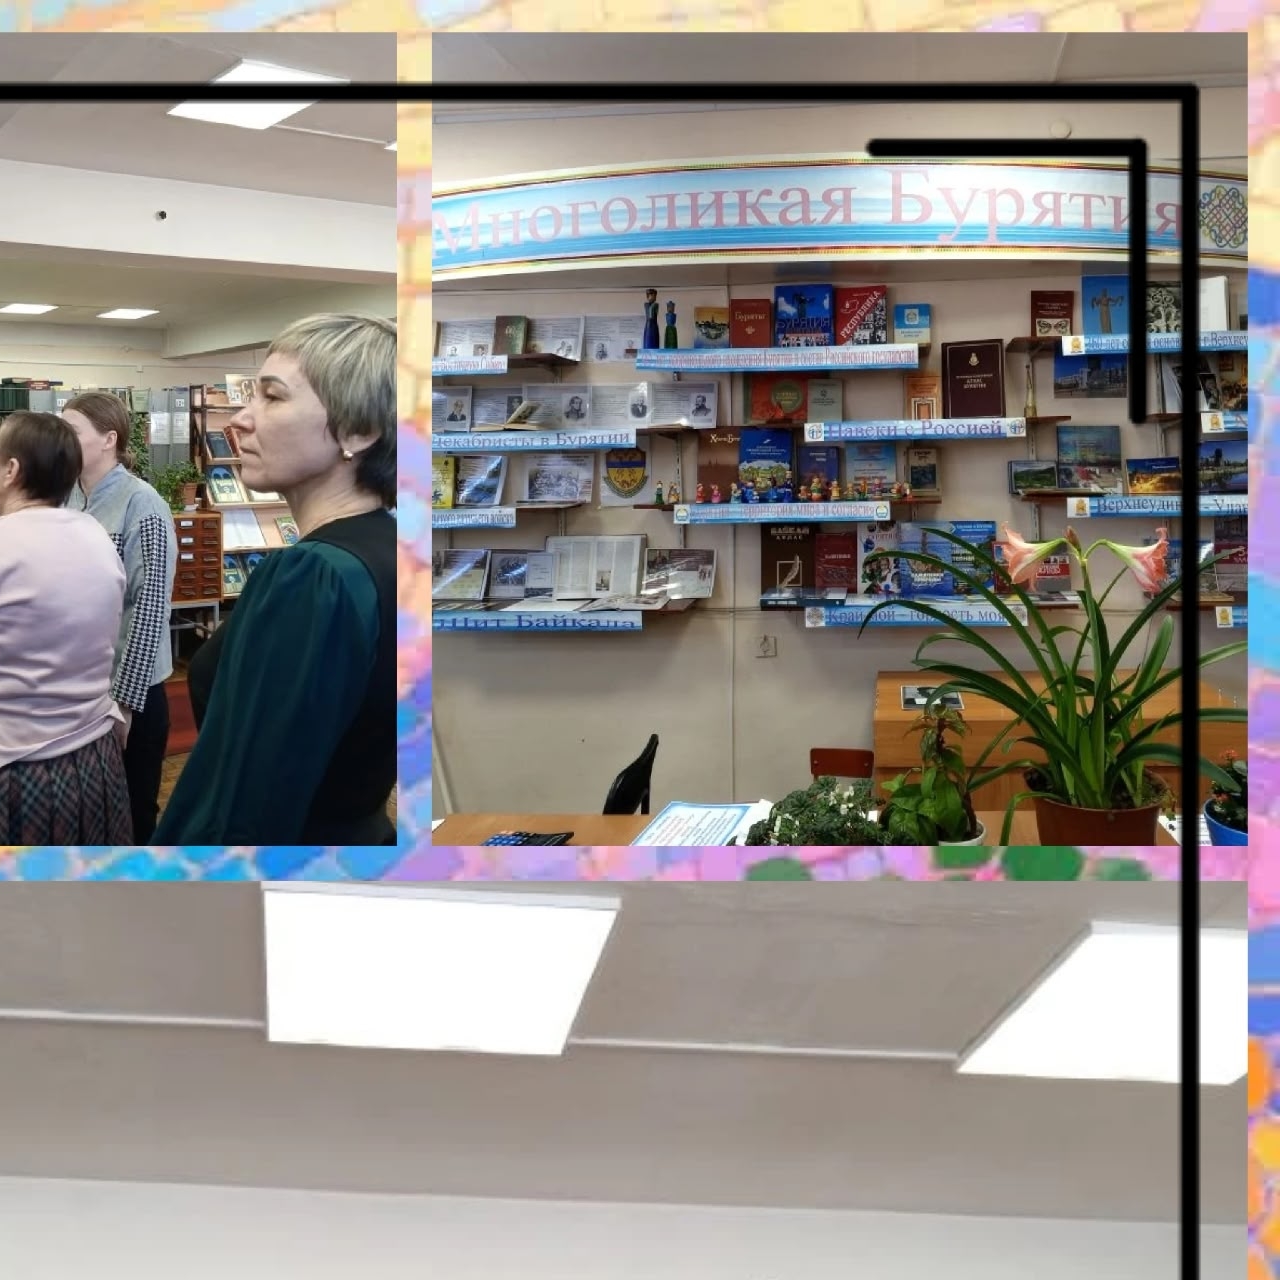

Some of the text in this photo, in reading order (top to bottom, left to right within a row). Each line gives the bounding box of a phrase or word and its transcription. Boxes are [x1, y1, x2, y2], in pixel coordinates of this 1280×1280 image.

[828, 423, 898, 440] Навеки
[921, 419, 1002, 437] Россией
[541, 437, 550, 446] в
[557, 431, 630, 448] Бурятии
[1096, 498, 1183, 513] Верхнеудин
[515, 613, 635, 630] Байкала
[828, 608, 864, 626] Край
